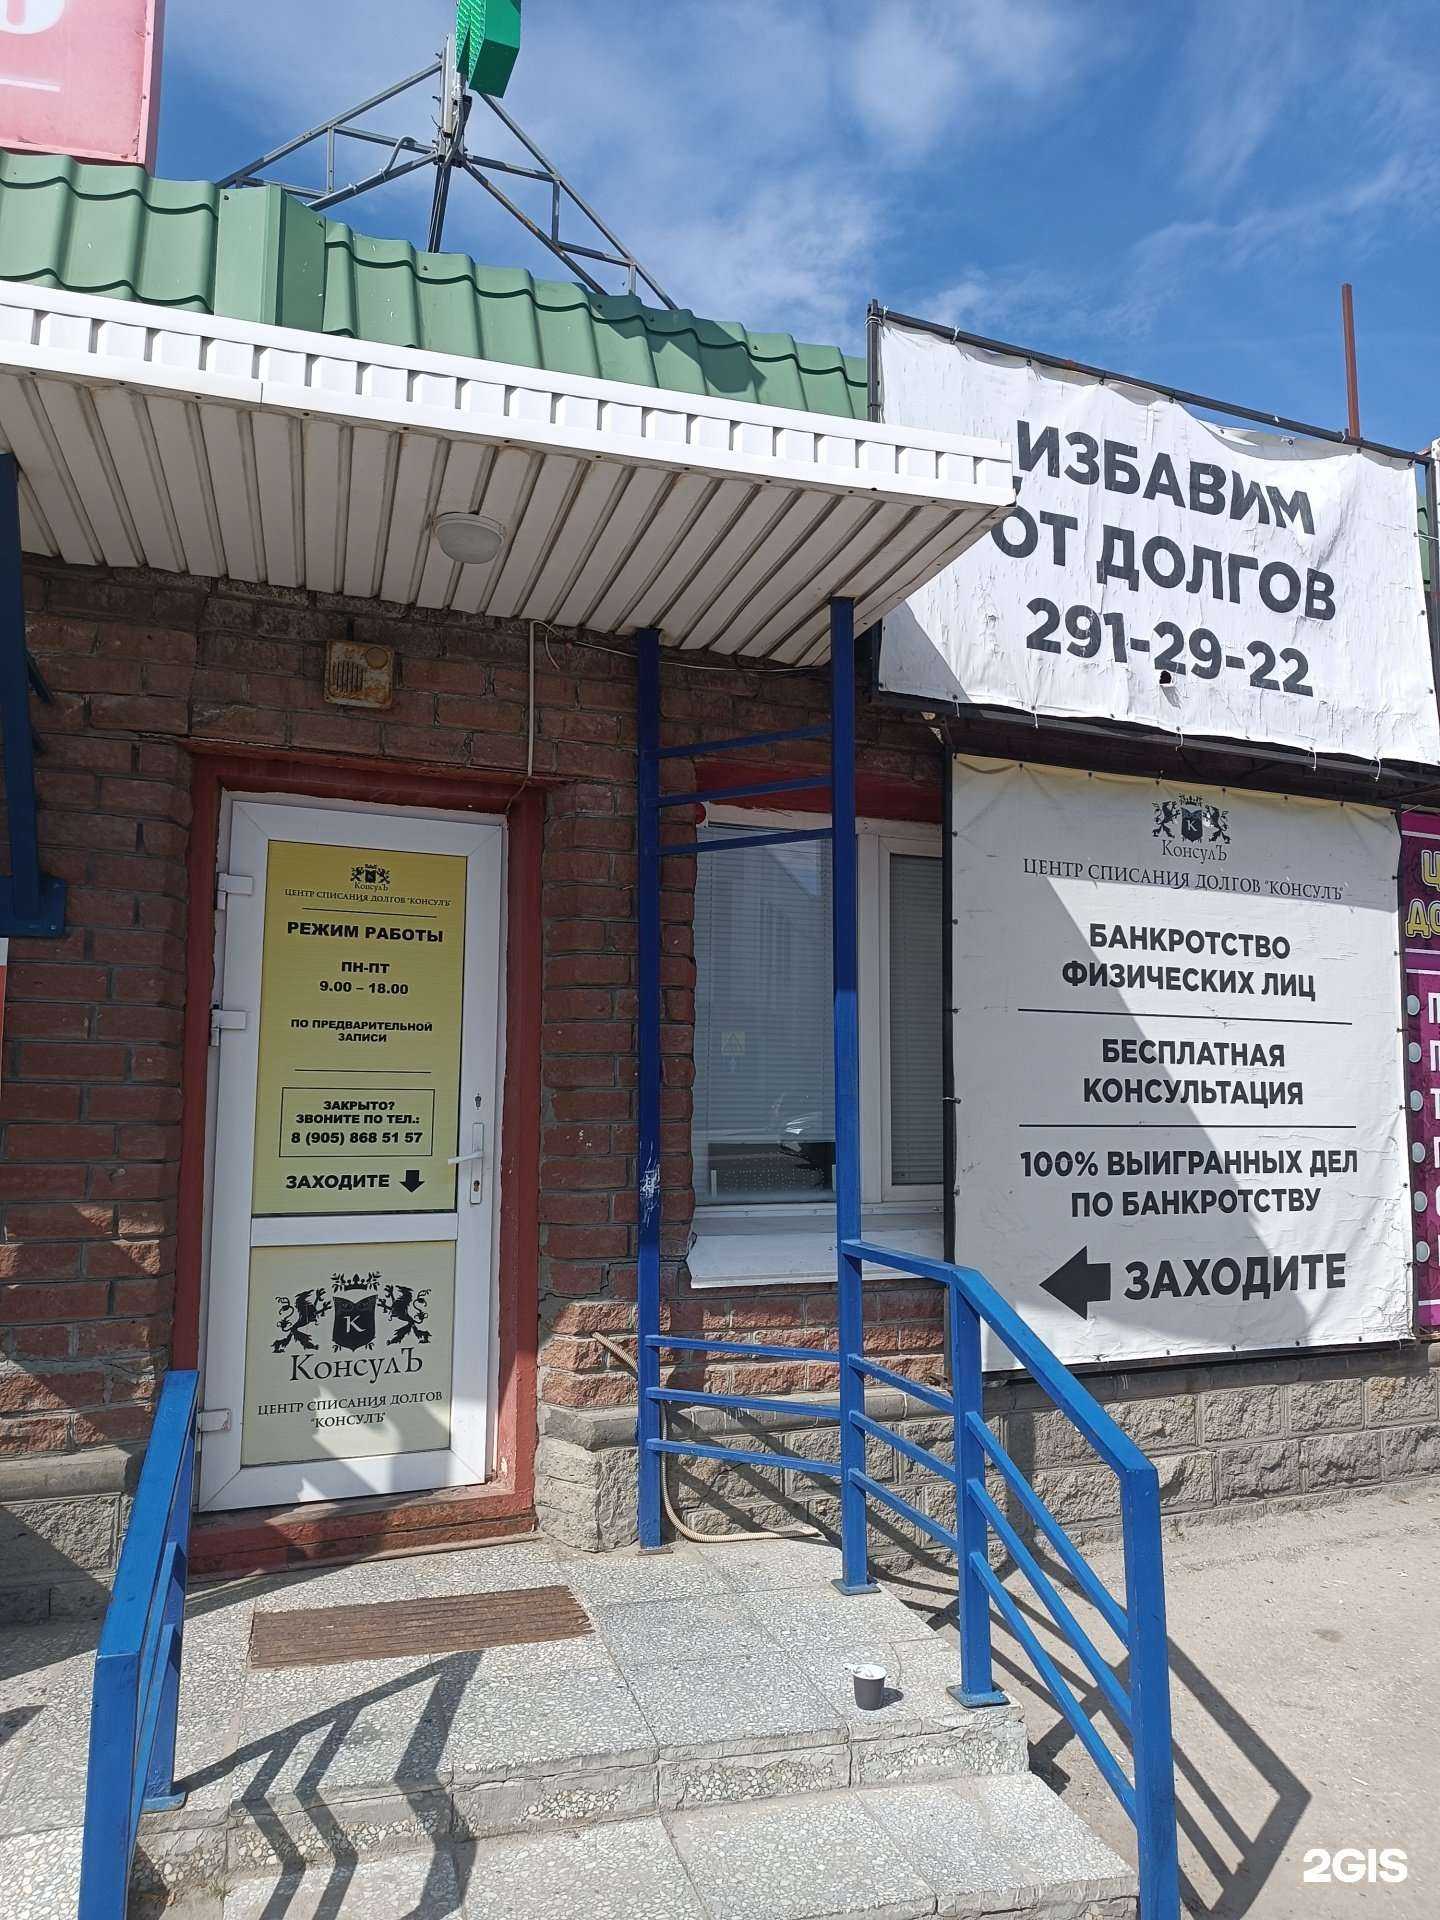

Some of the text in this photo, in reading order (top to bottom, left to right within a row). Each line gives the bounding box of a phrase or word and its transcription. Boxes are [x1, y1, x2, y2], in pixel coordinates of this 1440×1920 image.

[1016, 419, 1315, 535] ИЗБАВИМ
[990, 505, 1337, 621] ОТ ДОЛГОВ
[1026, 597, 1314, 697] 291-29-22
[1023, 857, 1083, 878] ЦЕНТР
[1088, 863, 1190, 889] СПИСАНИЯ
[1194, 873, 1261, 894] ДОЛГОВ
[285, 888, 315, 897] ЦЕНТР
[316, 891, 369, 902] СПИСАНИЯ
[370, 895, 406, 904] ДОЛГОВ
[287, 921, 444, 943] РЕЖИМ РАБОТЫ
[1090, 923, 1290, 959] БАНКРОТСТВО
[341, 961, 390, 975] ПН-ПТ
[1062, 961, 1316, 1001] ФИЗИЧЕСКИХ ЛИЦ
[319, 981, 352, 994] 9.00
[369, 983, 409, 996] 18.00
[290, 1019, 433, 1033] ПО ПРЕДВАРИТЕЛЬНОЙ
[338, 1033, 387, 1043] ЗАПИСИ
[1102, 1038, 1285, 1067] БЕСПЛАТНАЯ
[323, 1100, 395, 1111] ЗАКРЫТО?
[1083, 1078, 1304, 1108] КОНСУЛЬТАЦИЯ
[296, 1114, 420, 1125] ЗВОНИТЕ ПО ТЕЛ.:
[291, 1132, 423, 1146] 8 (905) 868 51 57
[1020, 1150, 1358, 1177] 100% ВЫИГРАННЫХ ДЕЛ
[286, 1174, 390, 1191] ЗАХОДИТЕ
[1071, 1188, 1321, 1218] ПО БАНКРОТСТВУ
[1124, 1253, 1347, 1301] ЗАХОДИТЕ
[257, 1391, 443, 1416] ЦЕНТР СПИСАНИЯ ДОЛГОВ
